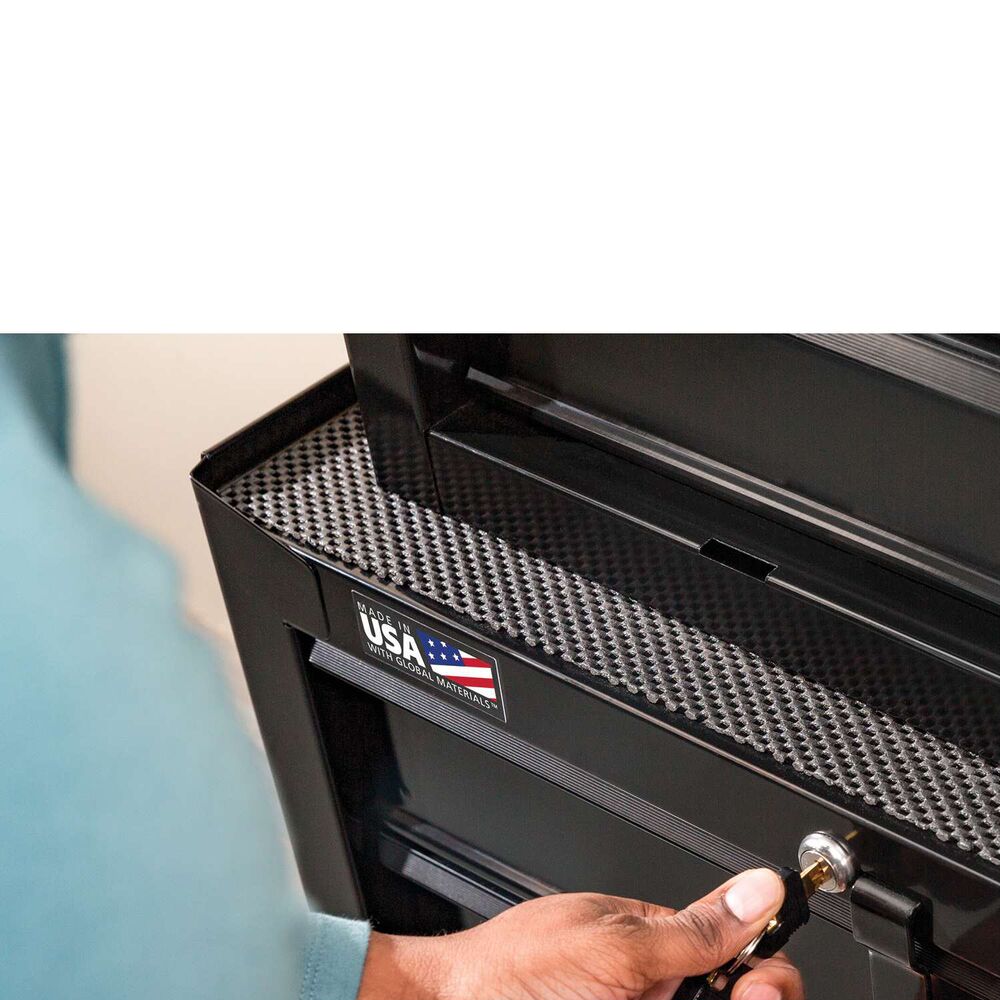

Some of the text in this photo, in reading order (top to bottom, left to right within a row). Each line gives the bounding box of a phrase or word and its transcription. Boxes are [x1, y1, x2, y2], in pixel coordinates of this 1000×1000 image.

[357, 601, 411, 635] MADE IN
[360, 612, 427, 669] USA
[367, 642, 394, 662] WITH
[396, 657, 434, 682] GLOBAL
